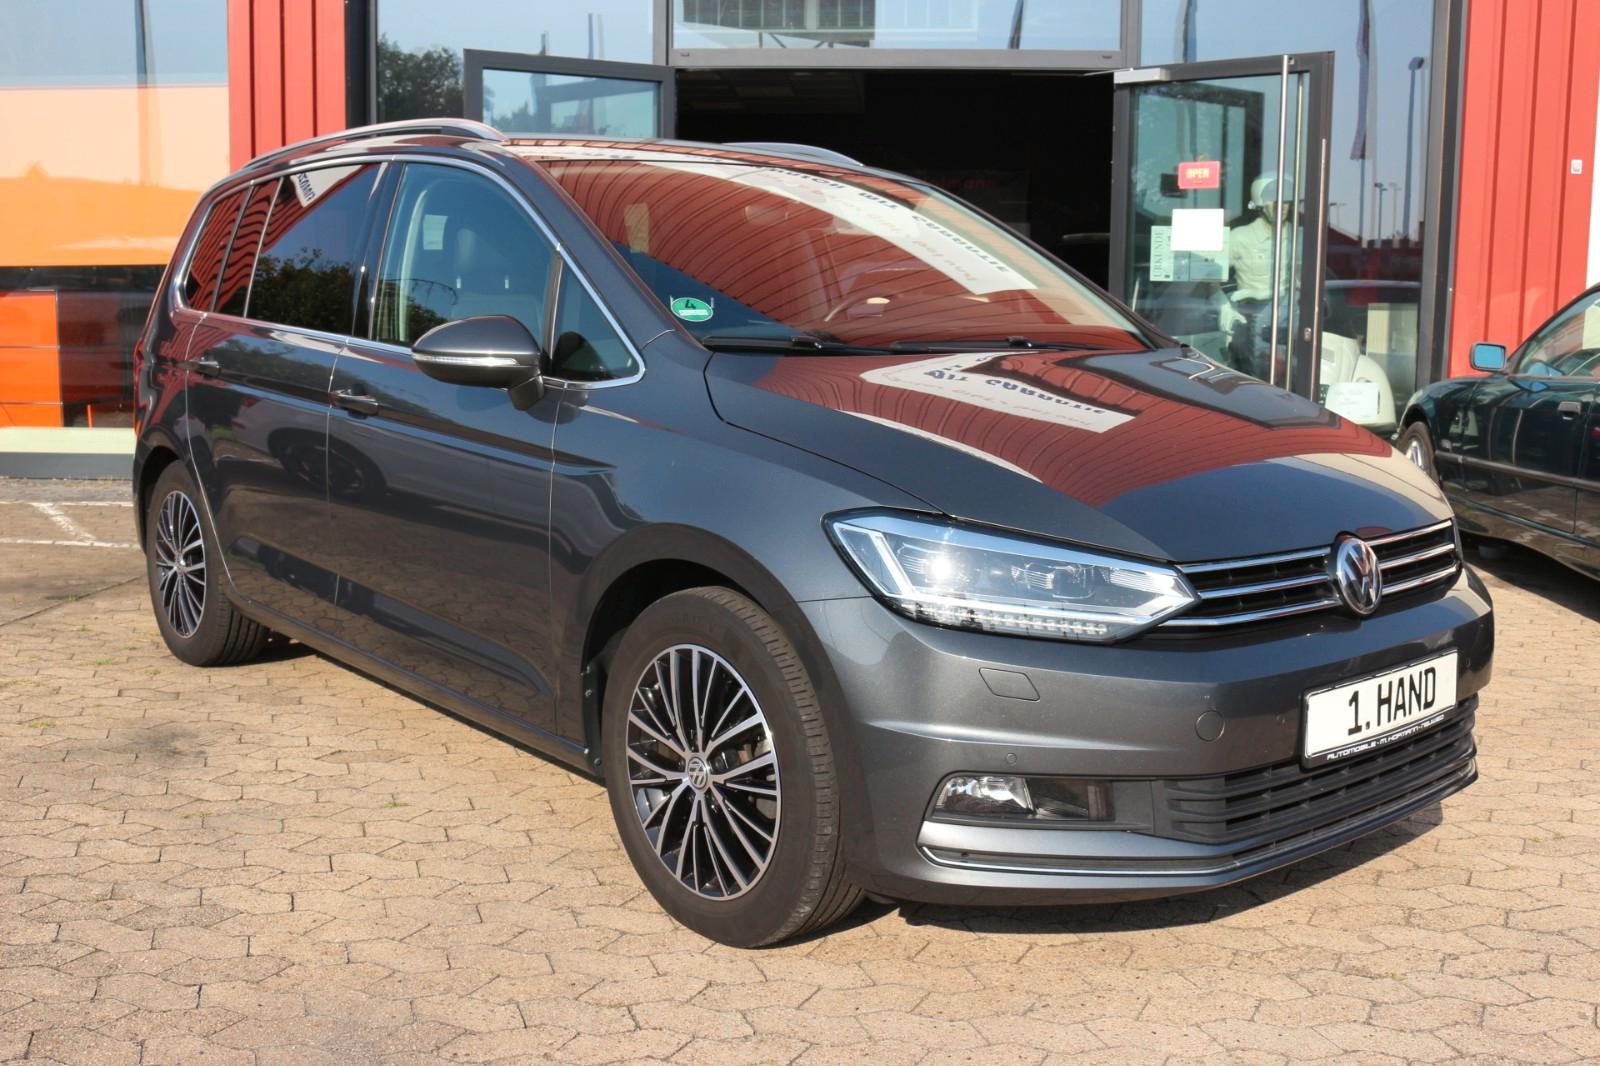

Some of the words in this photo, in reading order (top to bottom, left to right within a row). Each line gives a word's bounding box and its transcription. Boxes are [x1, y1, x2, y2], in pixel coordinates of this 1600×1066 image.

[1186, 168, 1209, 179] OPEN
[685, 299, 696, 309] 4
[1377, 667, 1436, 727] HAND
[1326, 740, 1376, 761] AUTOMOBILE
